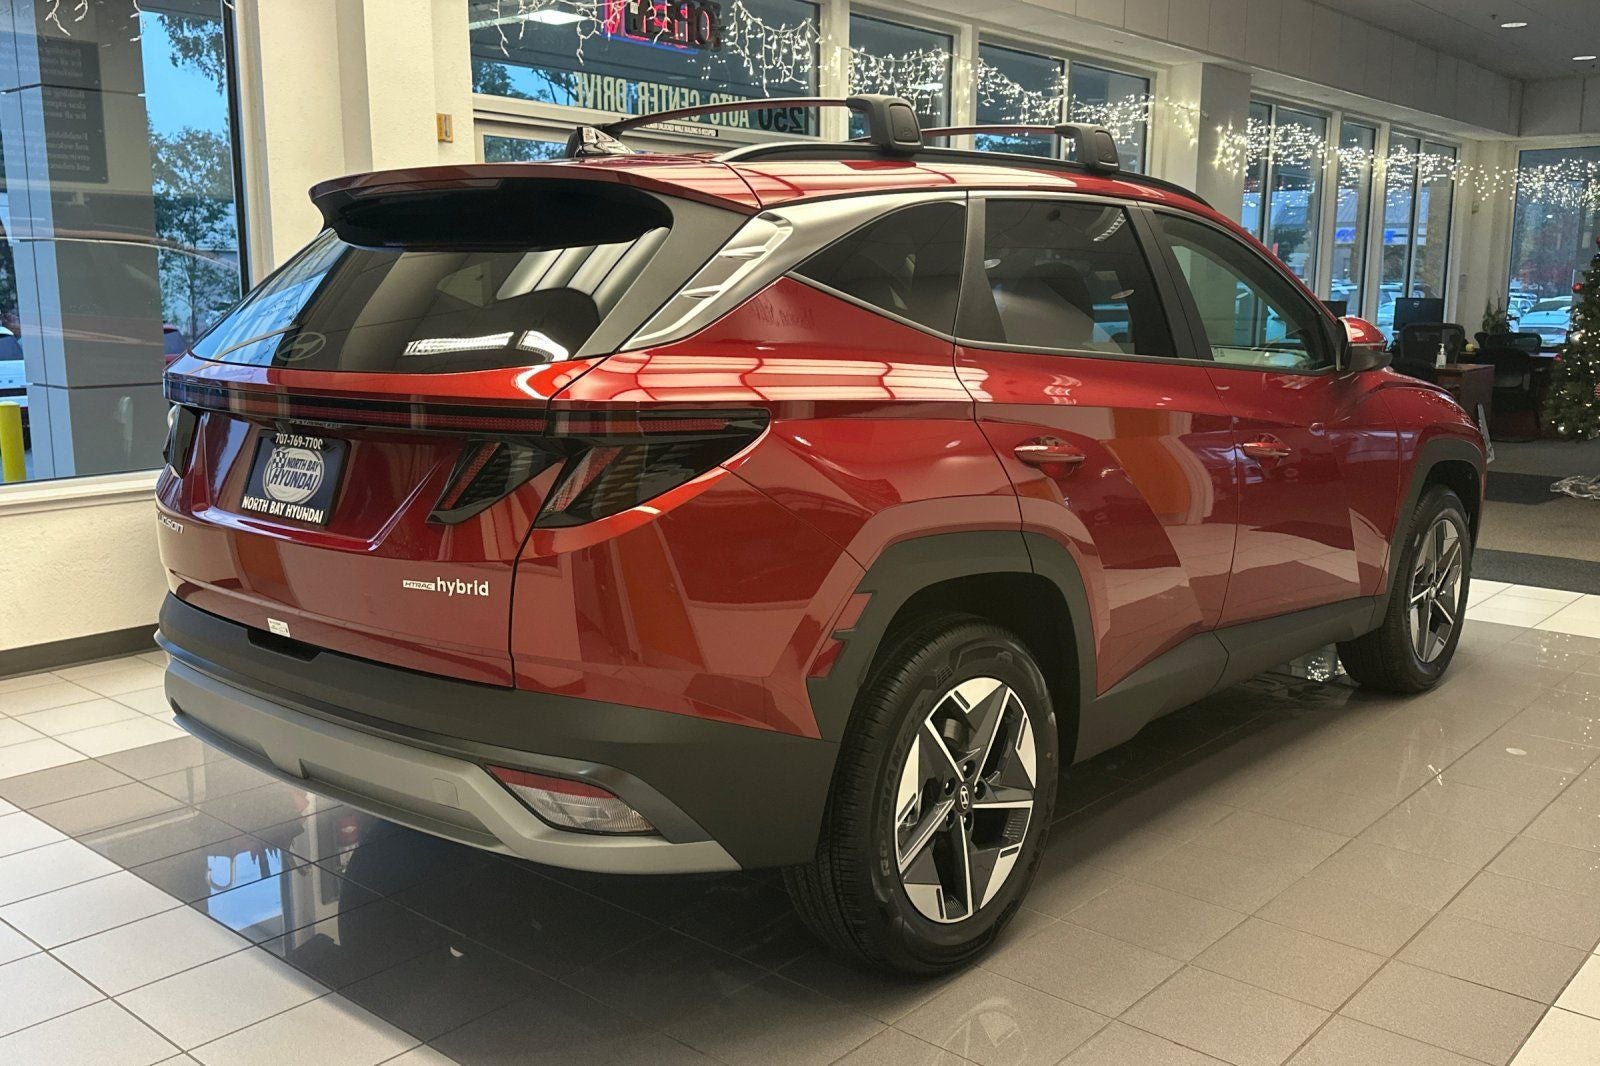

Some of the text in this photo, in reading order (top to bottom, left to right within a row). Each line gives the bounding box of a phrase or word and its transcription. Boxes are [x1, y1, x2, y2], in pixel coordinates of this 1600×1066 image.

[286, 457, 320, 472] NORTH BAY
[270, 468, 319, 491] HYUNDAI
[241, 495, 324, 524] NORTH BAY HYUNDAI
[436, 576, 489, 597] hybrid
